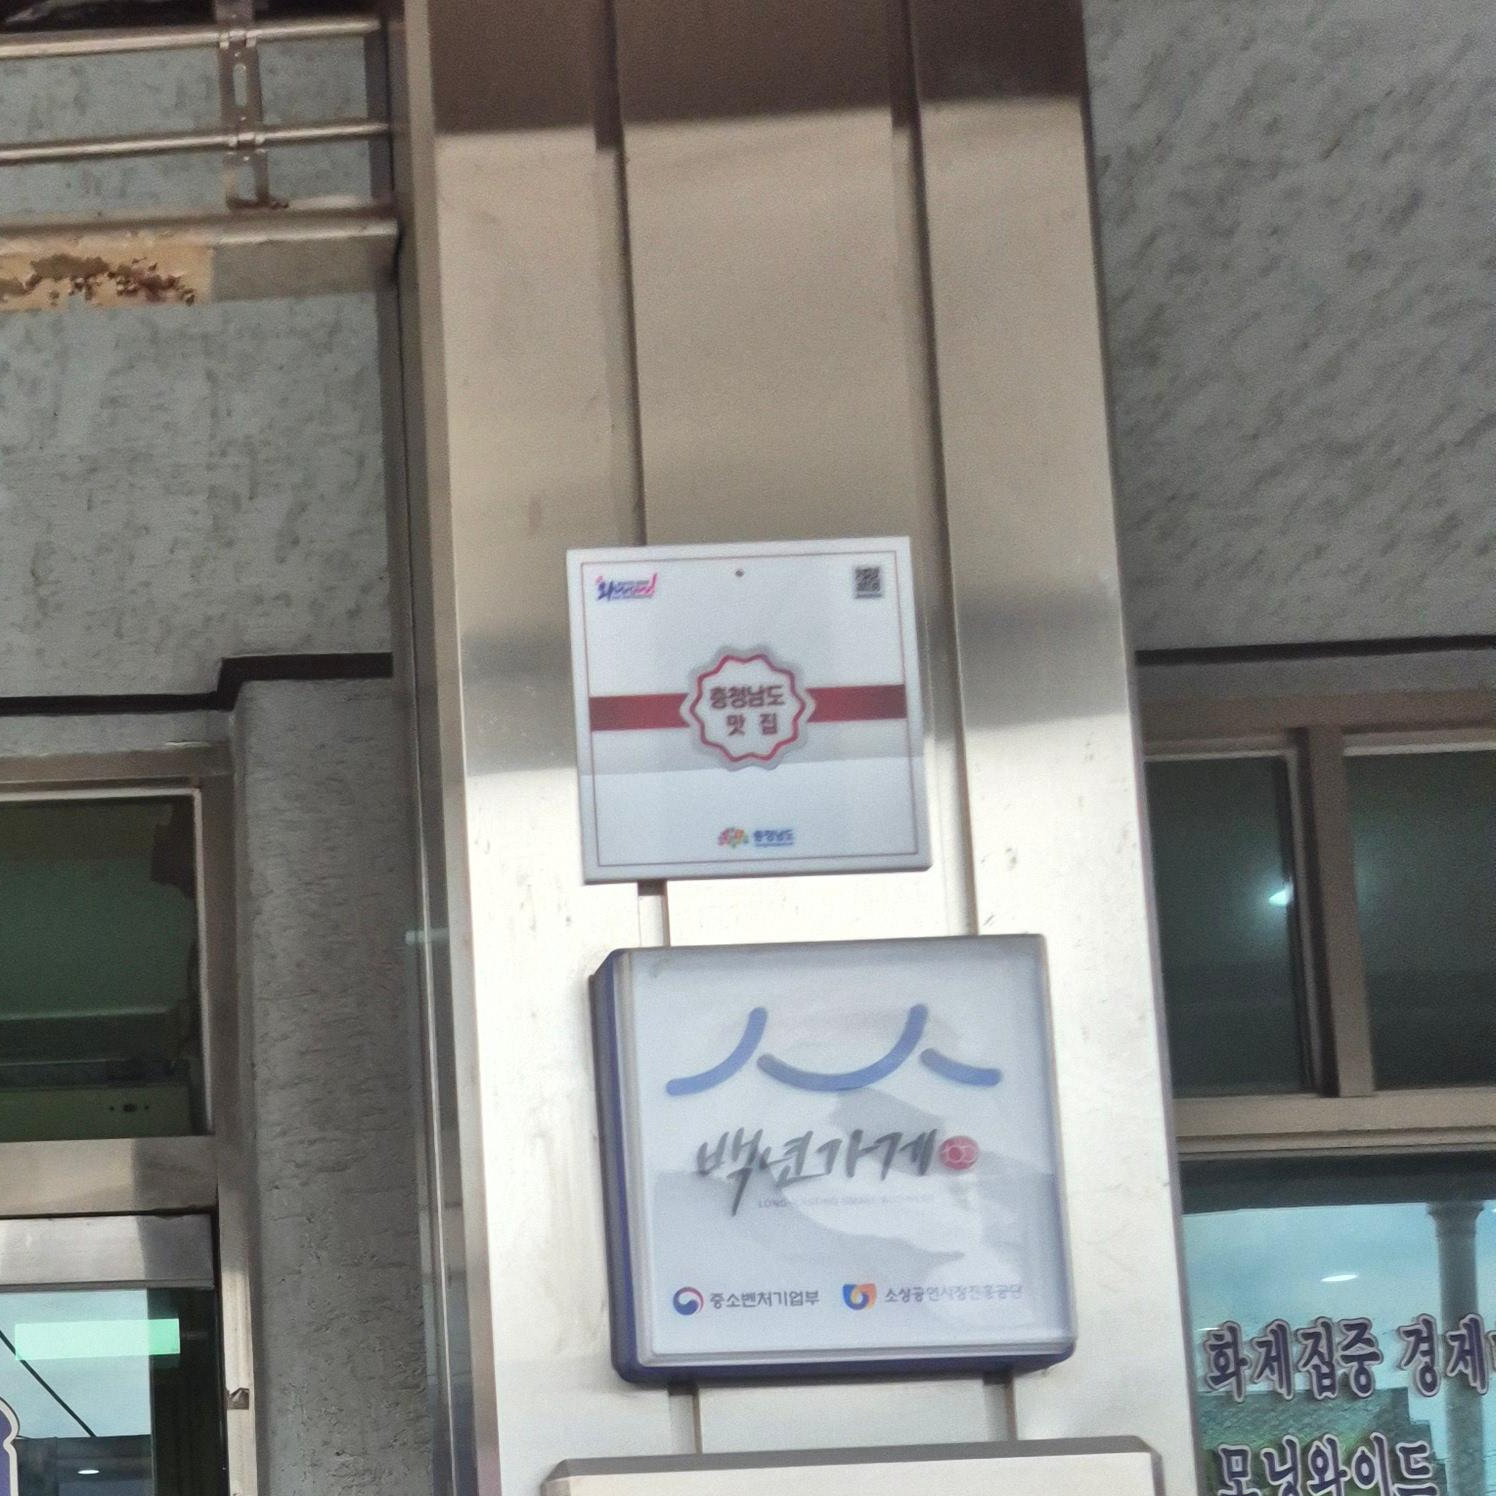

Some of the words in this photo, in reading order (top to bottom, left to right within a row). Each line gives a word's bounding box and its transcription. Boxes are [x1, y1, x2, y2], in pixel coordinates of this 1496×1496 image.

[710, 685, 786, 709] 충청남도
[695, 1127, 938, 1217] 백년가게
[710, 1290, 820, 1309] 중소벤처기업부
[1206, 1317, 1382, 1400] 화제집중
[1397, 1312, 1496, 1397] 경제
